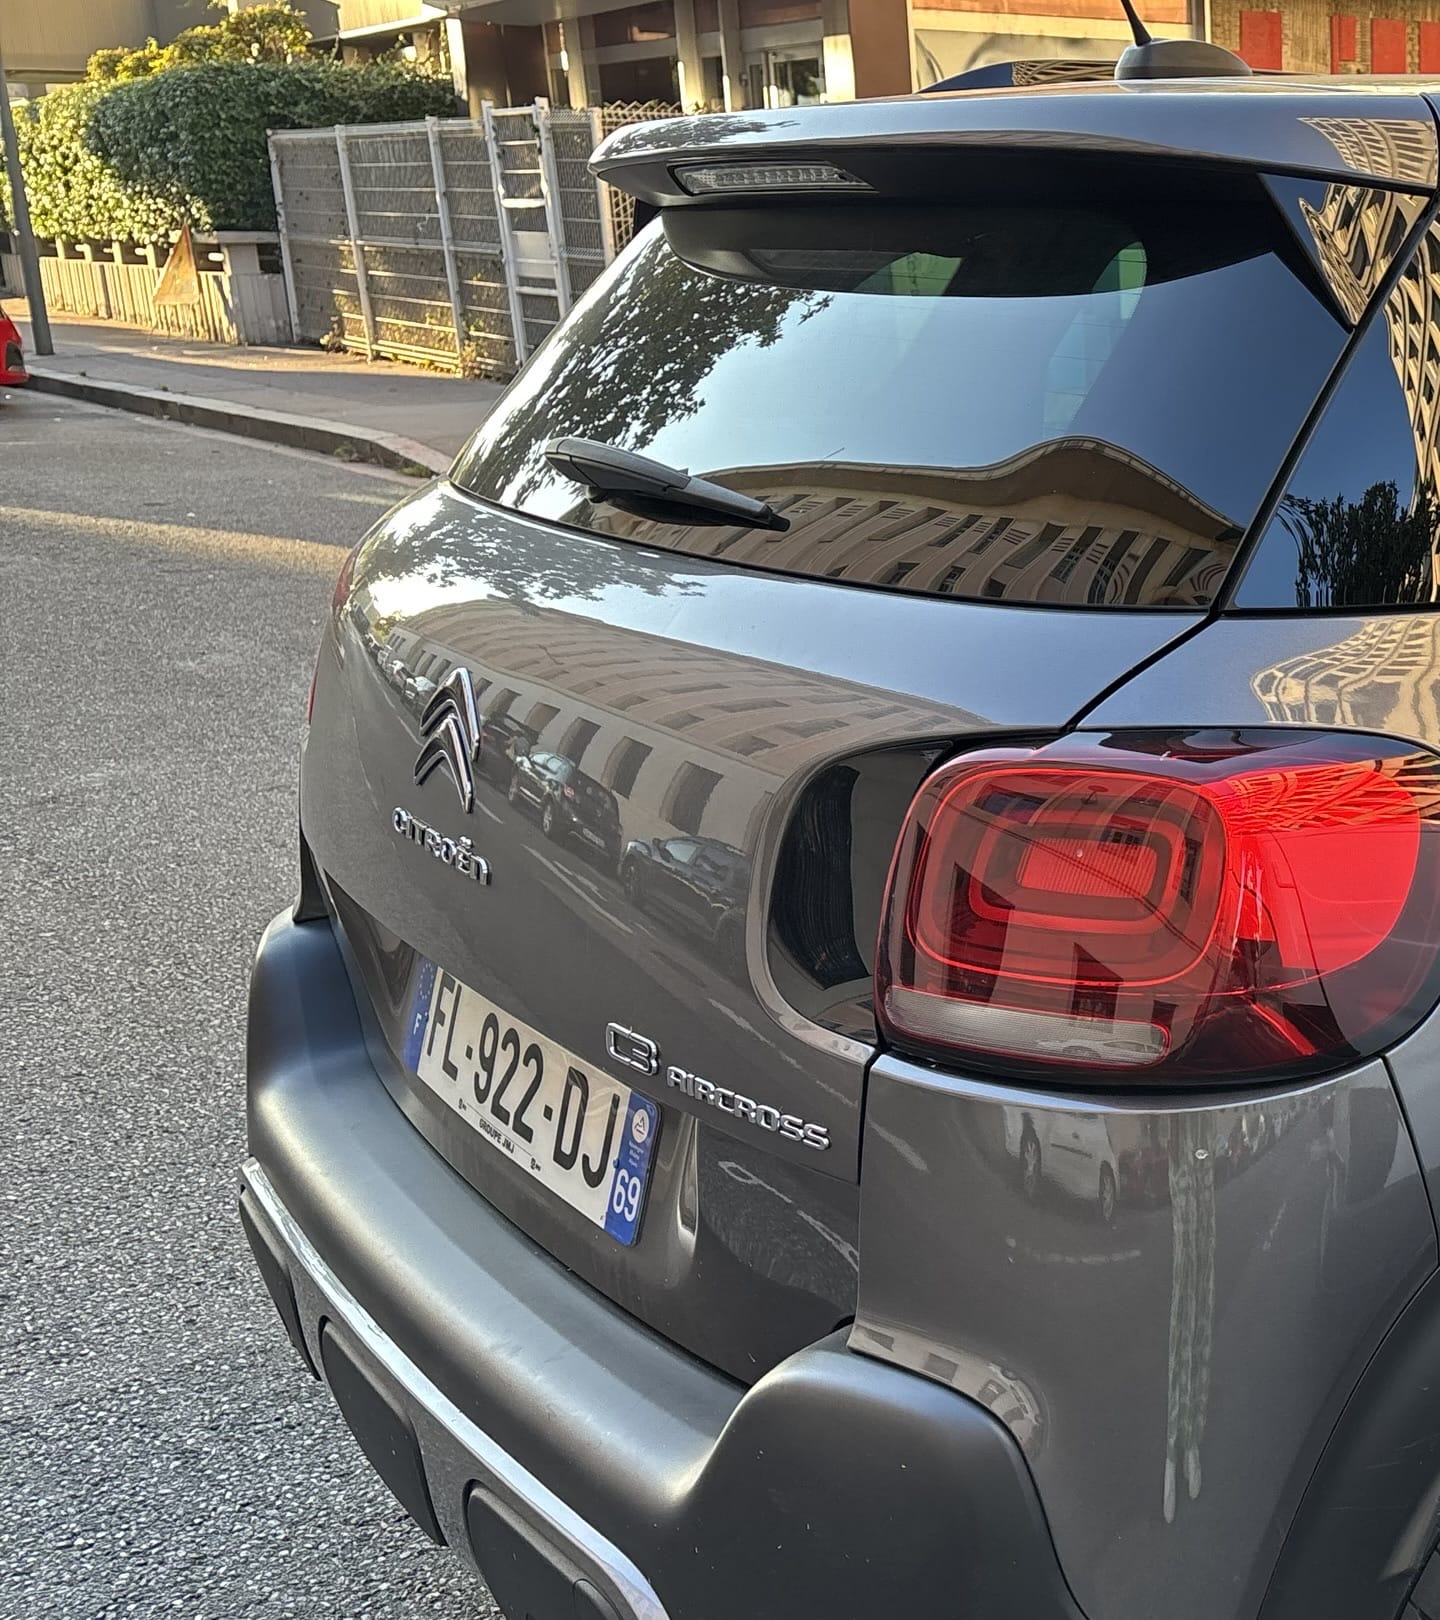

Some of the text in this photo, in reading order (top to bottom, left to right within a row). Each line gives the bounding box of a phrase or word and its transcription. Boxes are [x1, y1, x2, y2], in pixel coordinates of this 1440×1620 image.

[392, 807, 490, 886] CITROËN
[412, 1012, 423, 1036] F
[427, 970, 621, 1189] FL-922-DJ
[605, 1022, 831, 1151] C3 AIRCROSS
[479, 1118, 502, 1144] GROUPE
[613, 1168, 641, 1222] 69
